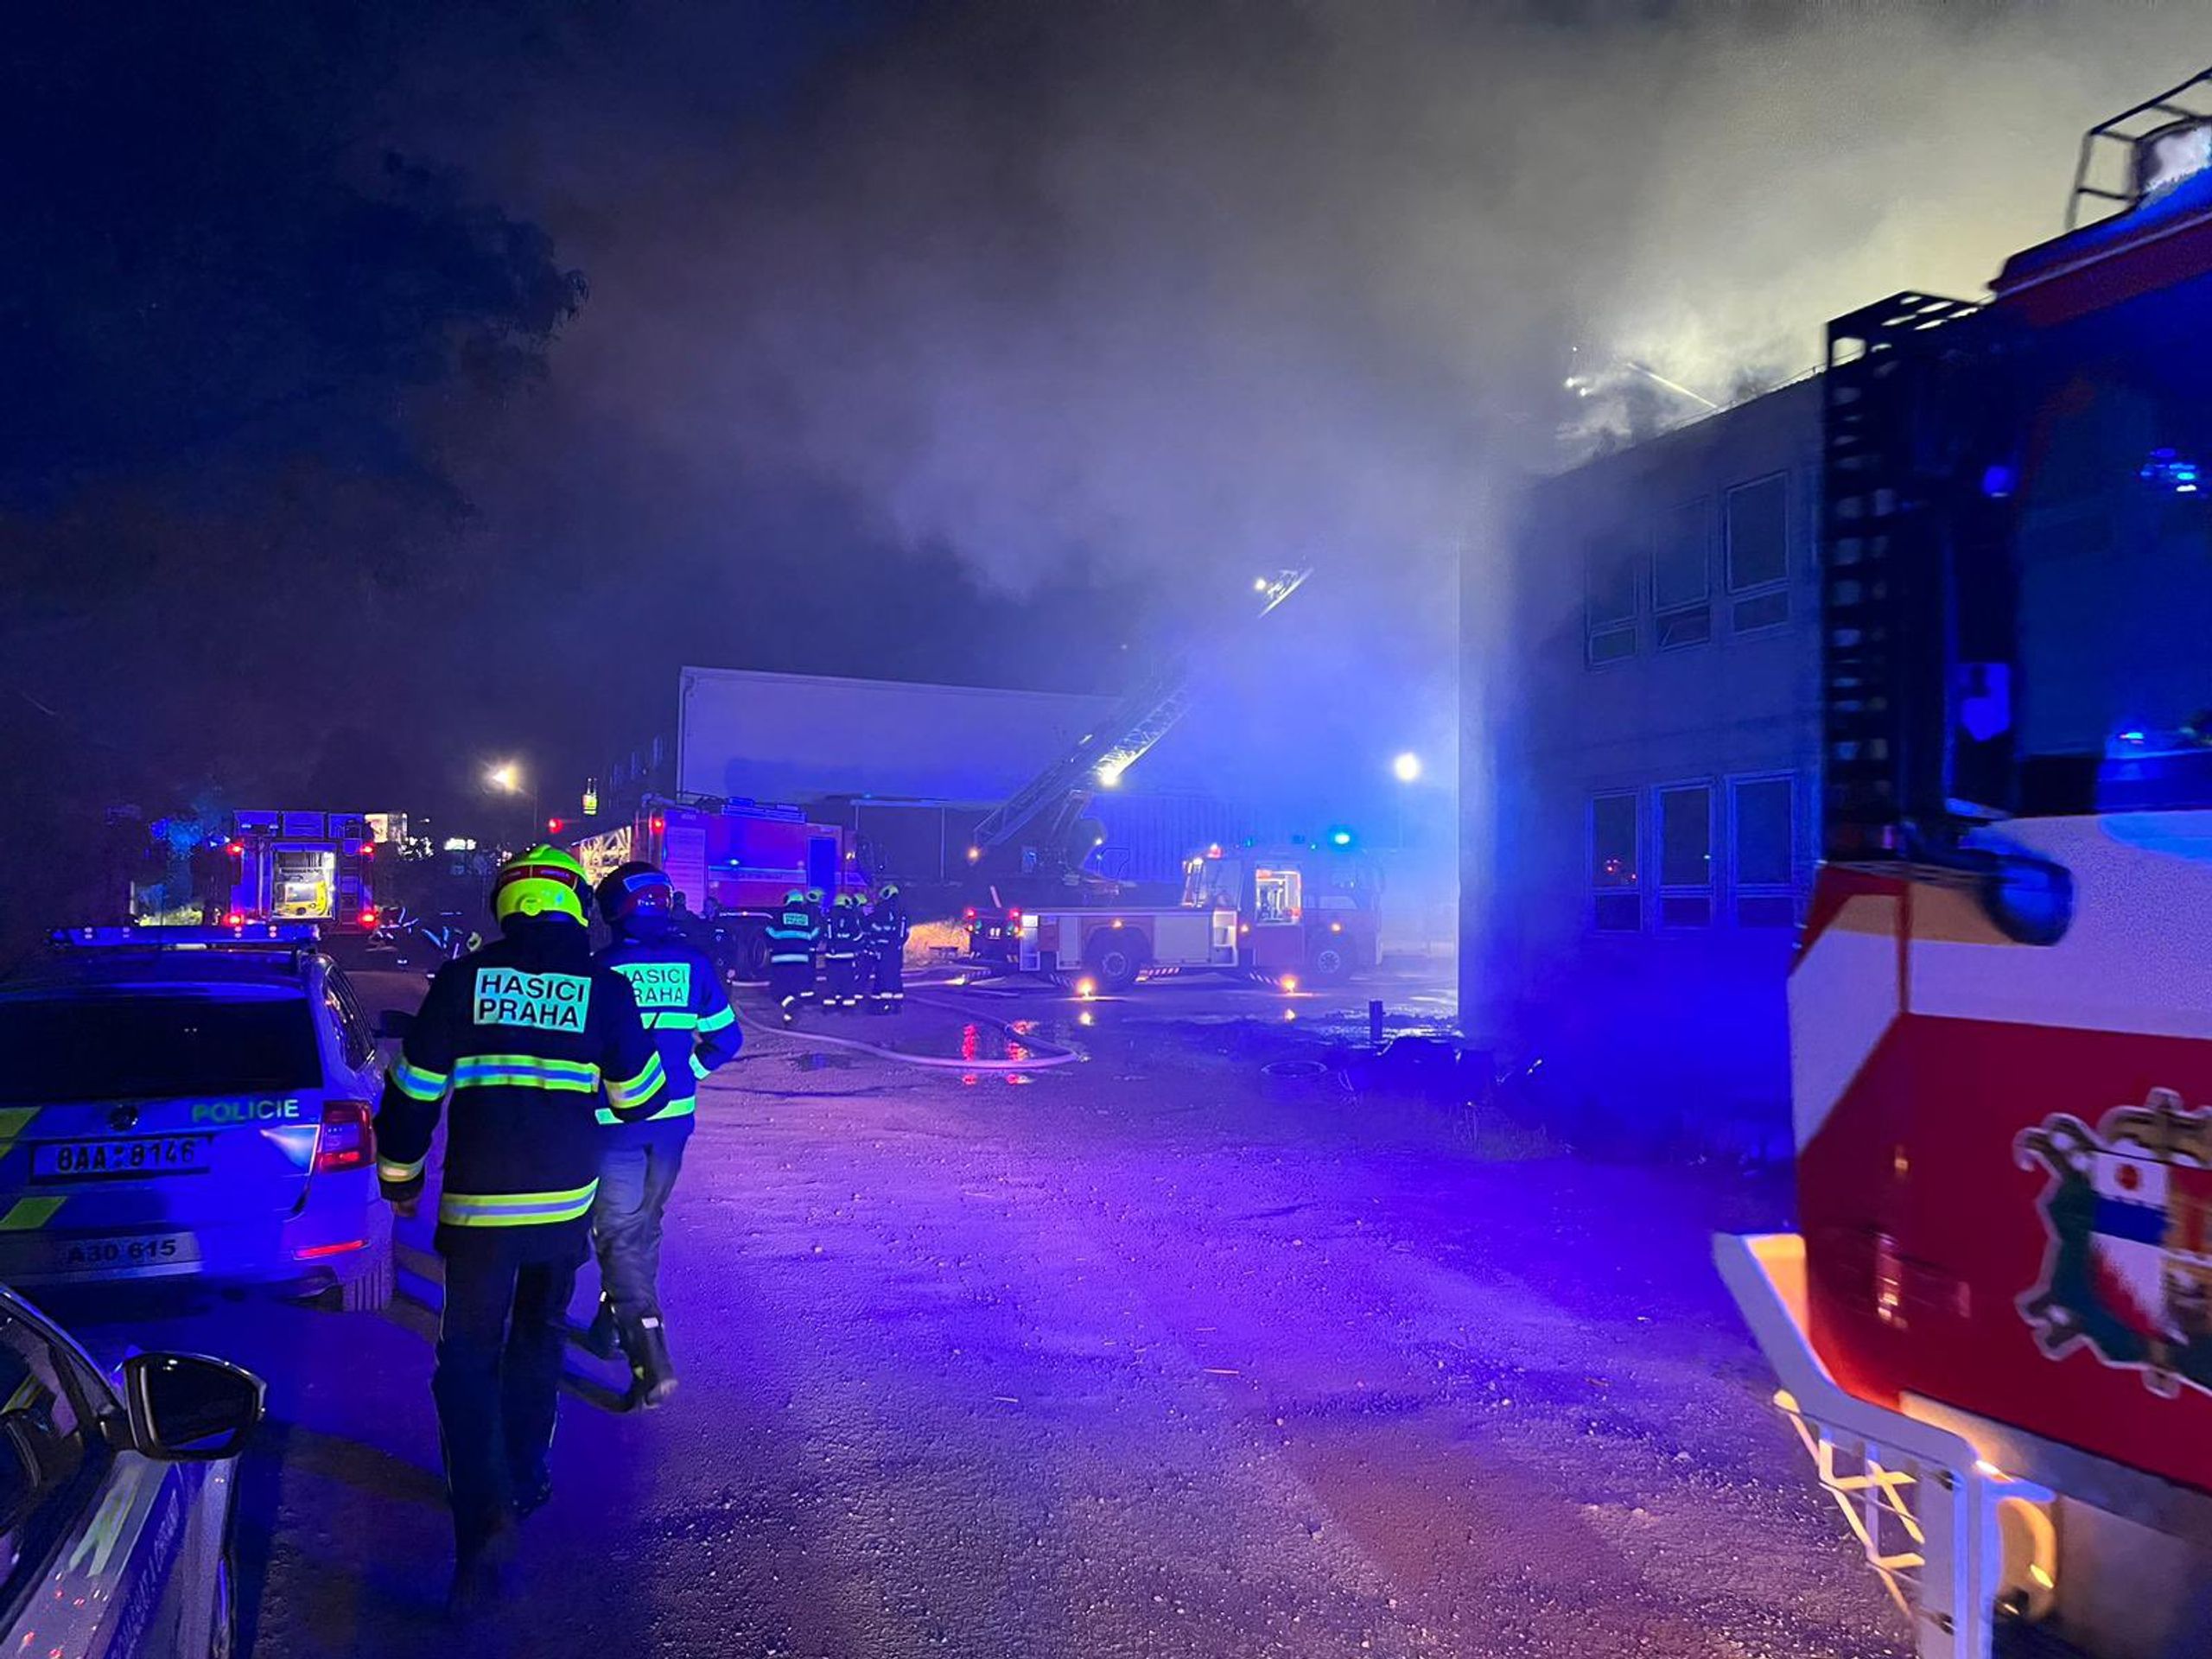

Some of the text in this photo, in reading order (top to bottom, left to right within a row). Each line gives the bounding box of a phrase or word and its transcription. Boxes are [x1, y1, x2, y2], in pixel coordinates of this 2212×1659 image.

[480, 974, 585, 1002] HASICI
[633, 987, 683, 1003] RAHA
[479, 998, 579, 1028] PRAHA
[192, 1098, 301, 1123] POLICIE
[57, 1138, 195, 1172] 8AA 8146
[129, 1238, 177, 1260] 615
